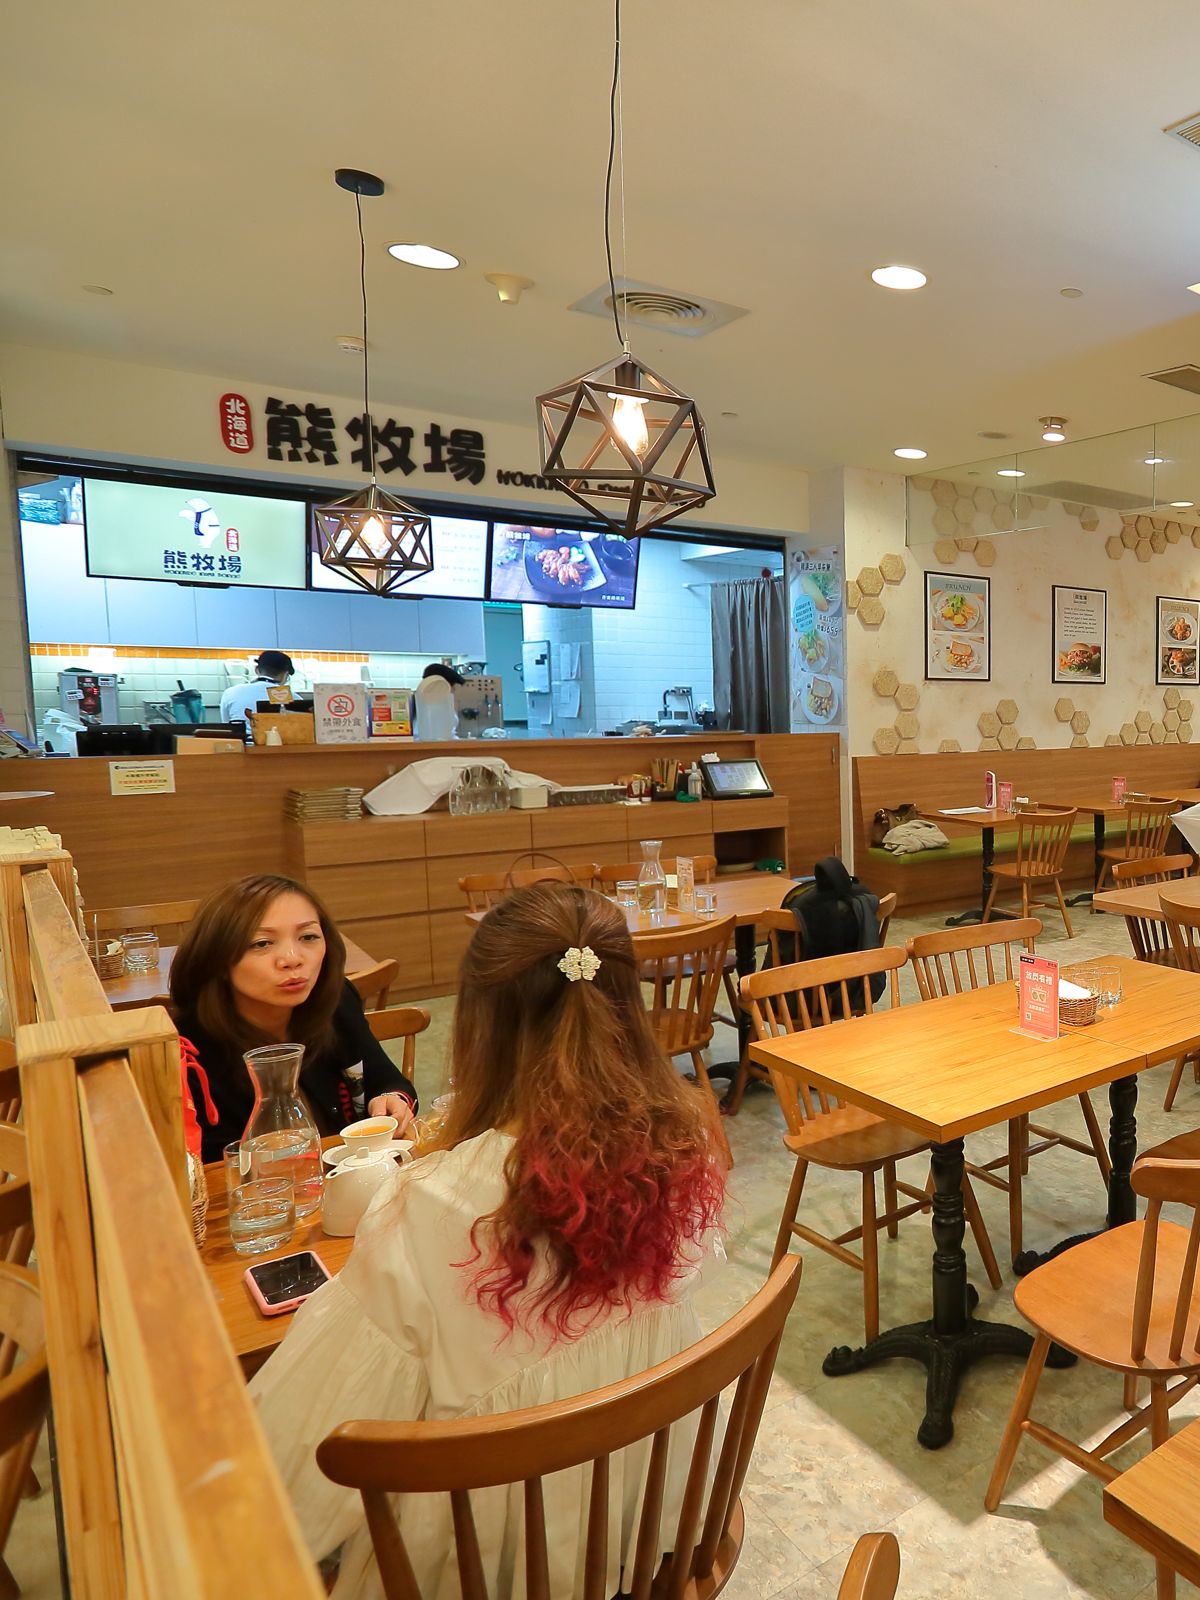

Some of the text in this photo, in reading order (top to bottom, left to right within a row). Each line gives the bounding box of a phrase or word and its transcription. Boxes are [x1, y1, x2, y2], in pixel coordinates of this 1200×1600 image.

[224, 398, 249, 449] 北海道
[264, 396, 486, 486] 熊牧場
[163, 550, 242, 573] 熊牧場
[322, 717, 362, 728] 禁帶外食
